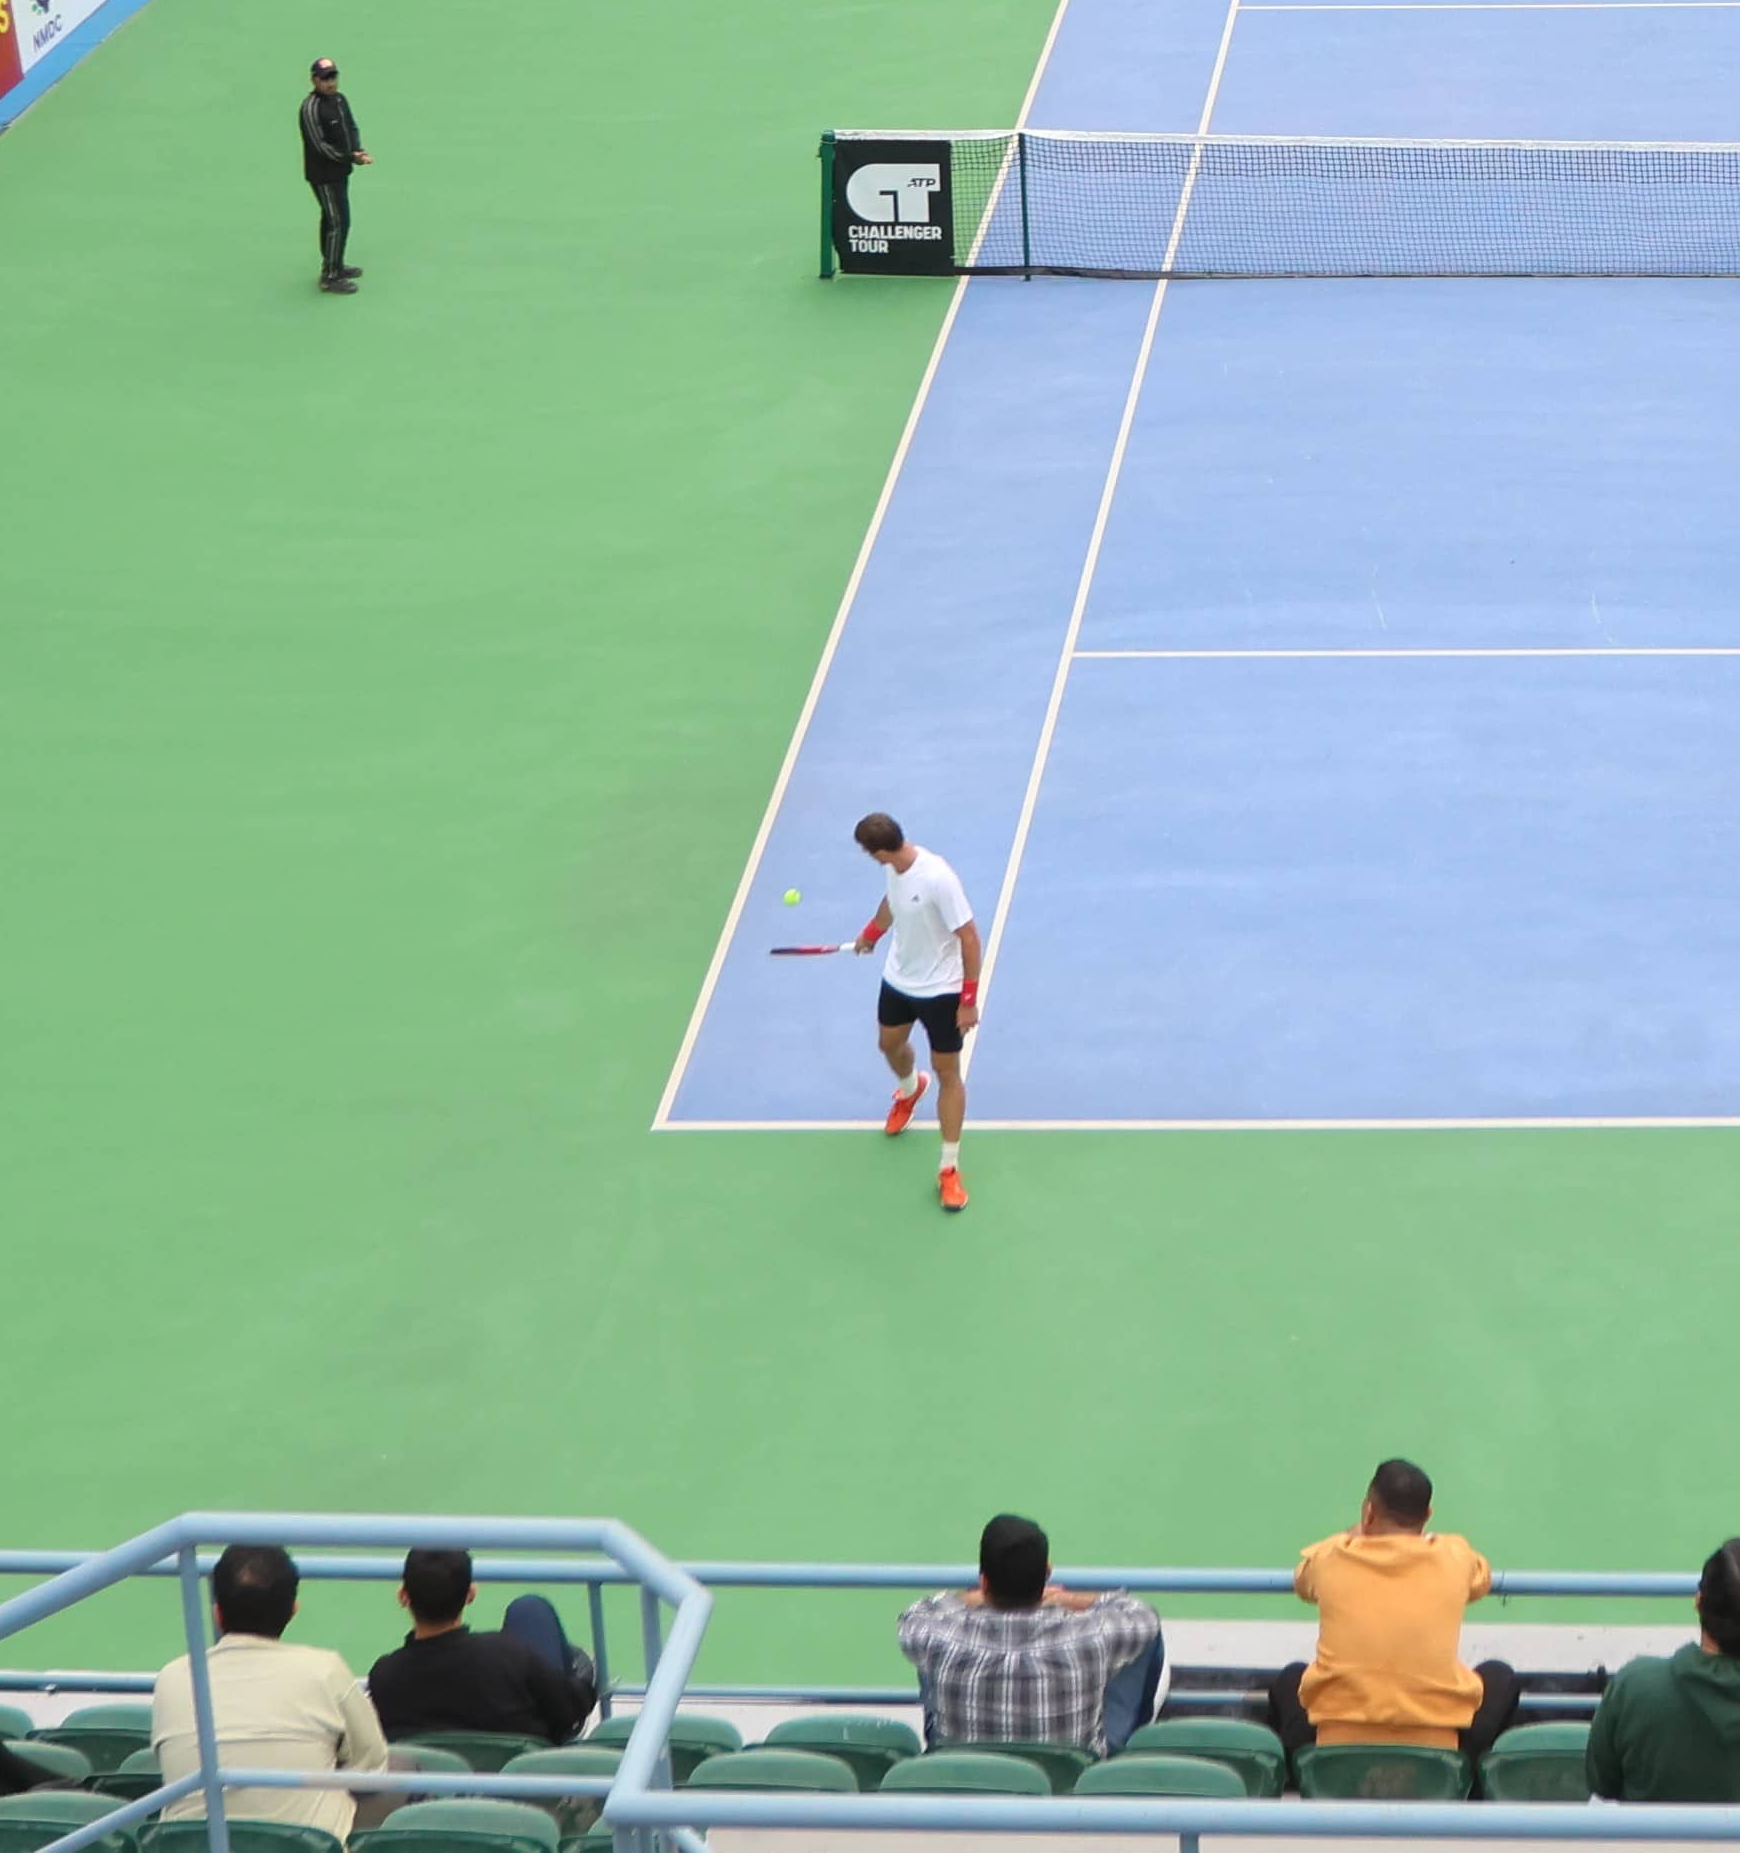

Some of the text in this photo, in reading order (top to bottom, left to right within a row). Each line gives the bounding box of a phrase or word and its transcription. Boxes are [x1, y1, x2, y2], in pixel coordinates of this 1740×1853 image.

[33, 14, 62, 52] NMDC
[907, 178, 936, 188] ATP
[848, 225, 942, 240] CHALLENGER
[849, 239, 888, 253] TOUR
